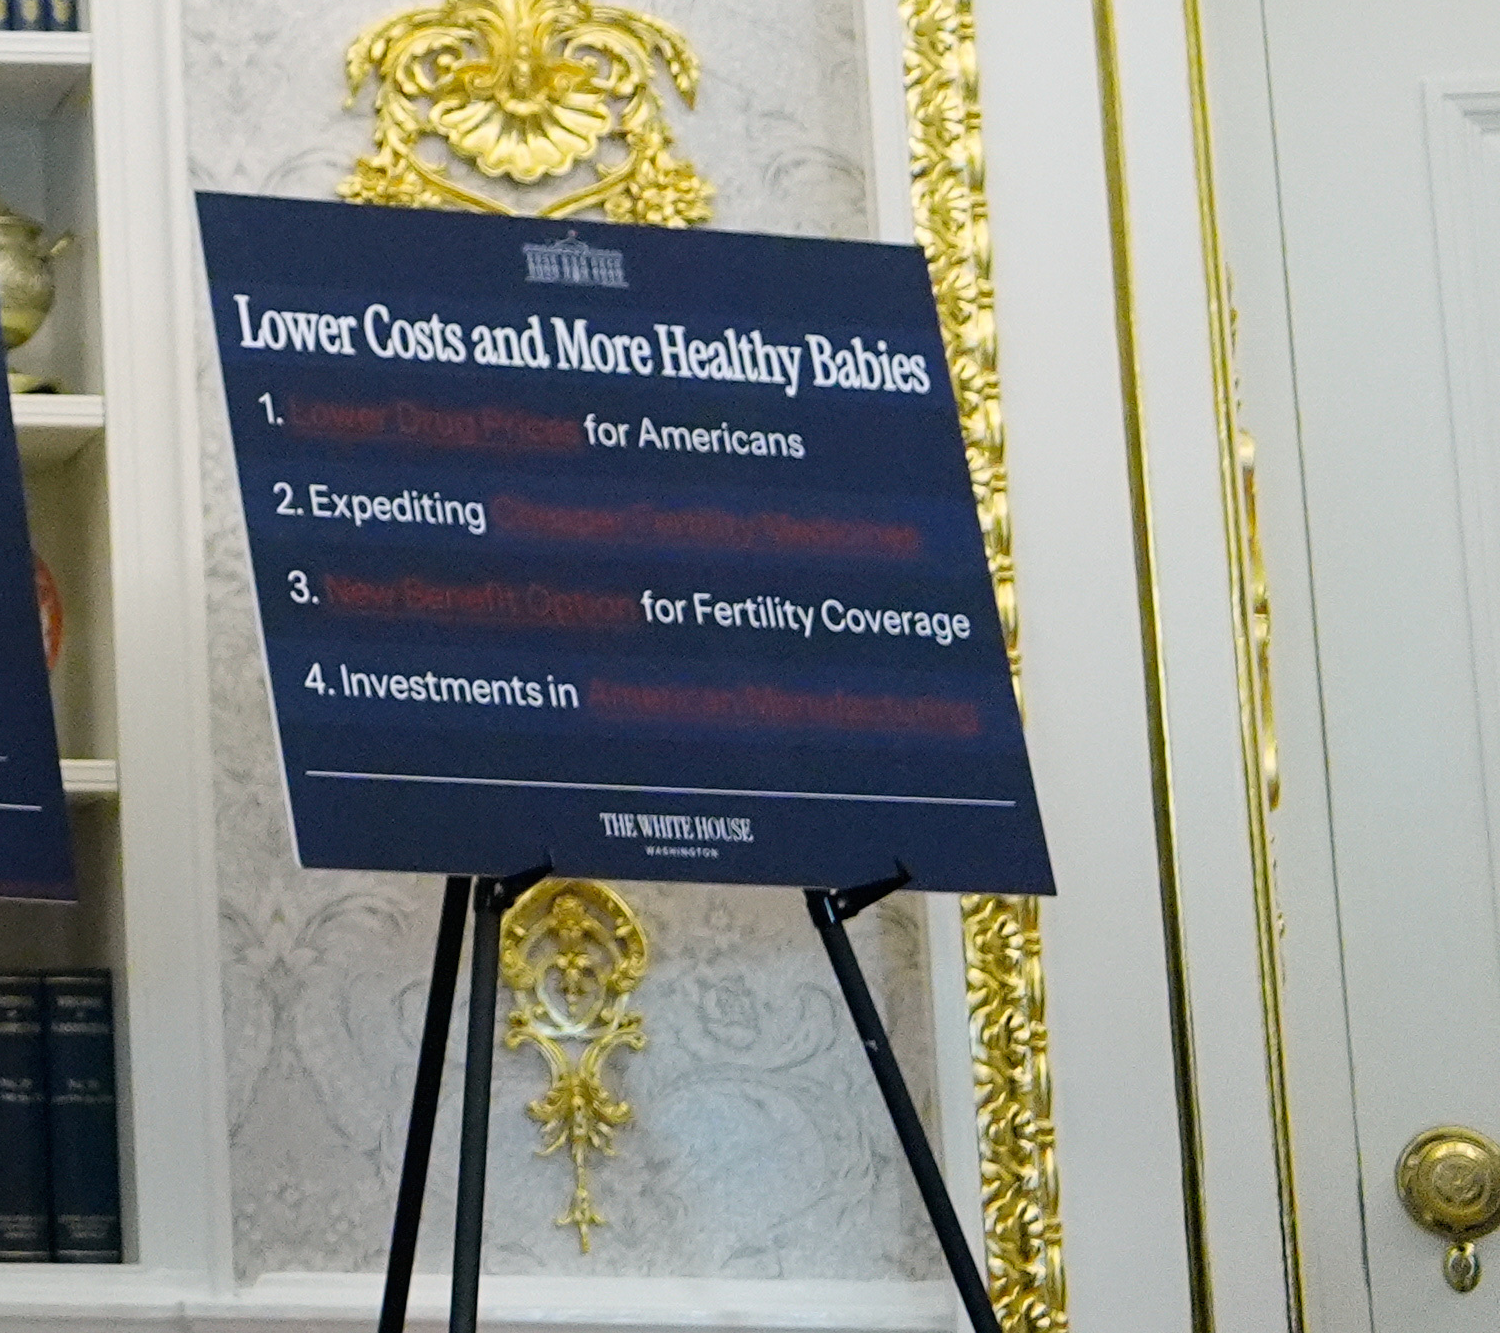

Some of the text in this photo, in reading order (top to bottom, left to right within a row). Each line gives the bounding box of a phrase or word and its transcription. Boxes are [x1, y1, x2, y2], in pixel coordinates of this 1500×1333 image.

[233, 293, 931, 398] Lower Costs and More Healthy Babies
[258, 391, 285, 426] 1.
[583, 413, 630, 448] for
[638, 416, 806, 459] Americans
[273, 481, 305, 517] 2.
[307, 483, 488, 536] Expediting
[287, 569, 320, 605] 3.
[641, 589, 687, 625] for
[692, 592, 815, 639] Fertility
[820, 598, 972, 646] Coverage
[303, 661, 336, 696] 4.
[339, 663, 545, 709] Investments
[546, 674, 581, 709] in
[599, 812, 755, 844] THE WHITE HOUSE
[645, 845, 721, 860] WASHINGTON
